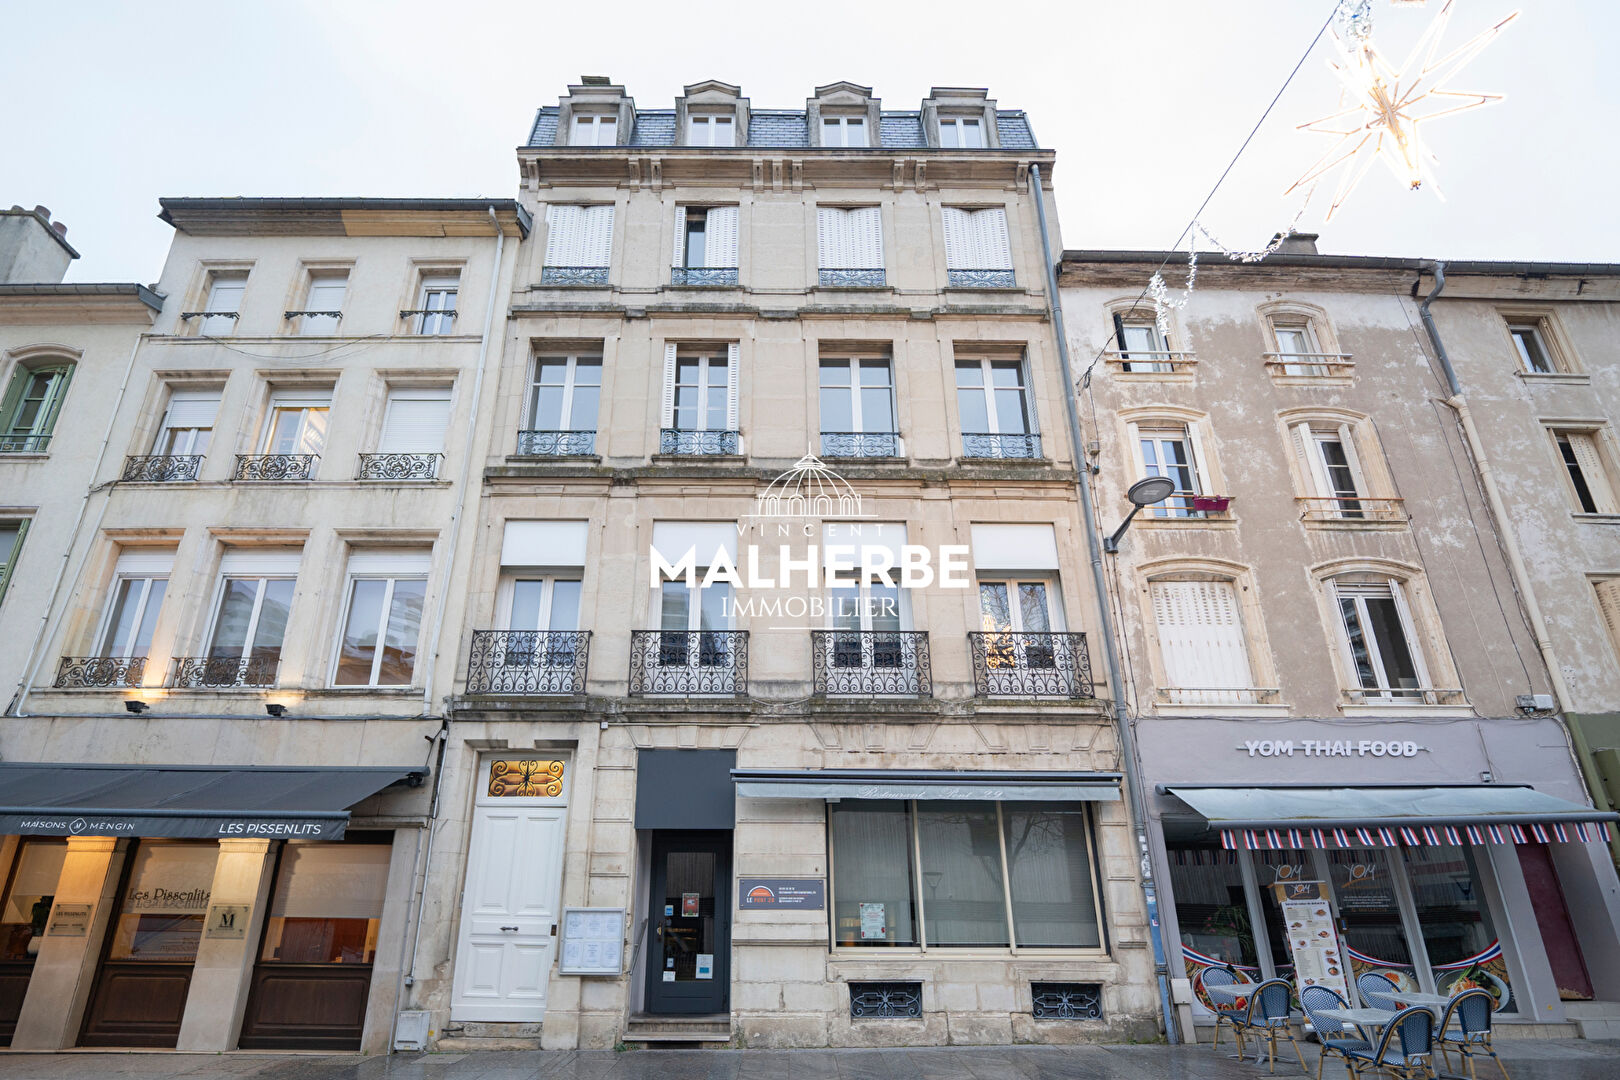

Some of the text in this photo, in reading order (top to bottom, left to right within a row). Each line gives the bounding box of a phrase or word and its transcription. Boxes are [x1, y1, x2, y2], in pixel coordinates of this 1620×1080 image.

[1245, 740, 1417, 757] YOM THAI FOOD
[20, 821, 67, 829] MAISONS
[89, 822, 135, 830] MENGIN
[219, 823, 321, 835] LES PISSENLITS
[1344, 864, 1376, 881] YOM
[128, 888, 211, 901] Les Pissenlits
[220, 913, 236, 928] M
